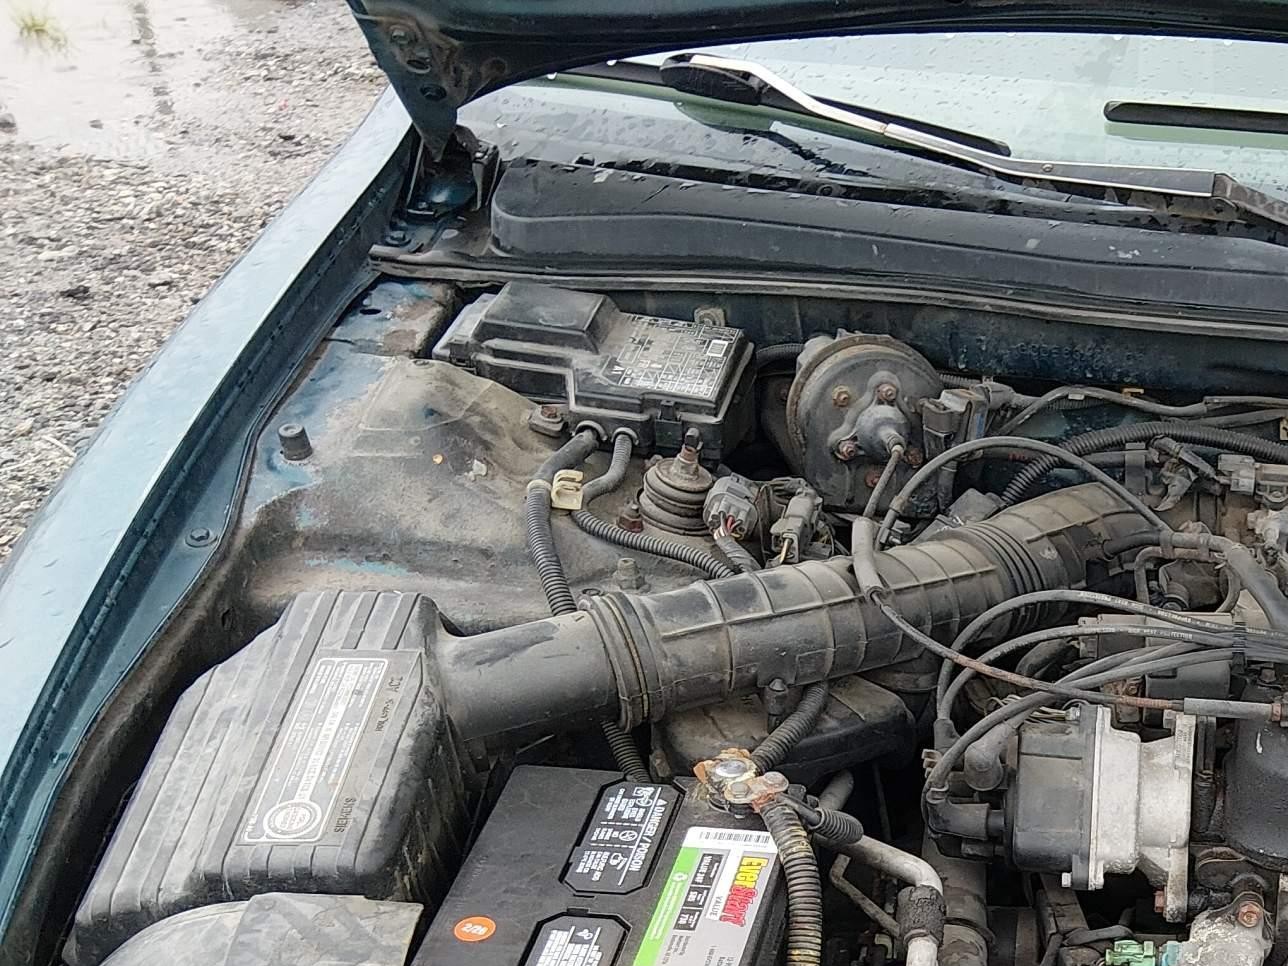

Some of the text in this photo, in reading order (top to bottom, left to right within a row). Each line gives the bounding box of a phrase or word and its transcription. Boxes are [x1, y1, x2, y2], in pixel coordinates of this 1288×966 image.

[643, 806, 666, 836] DANGER
[629, 842, 651, 871] POISON
[709, 896, 724, 917] VALUE
[719, 856, 769, 928] EverStart
